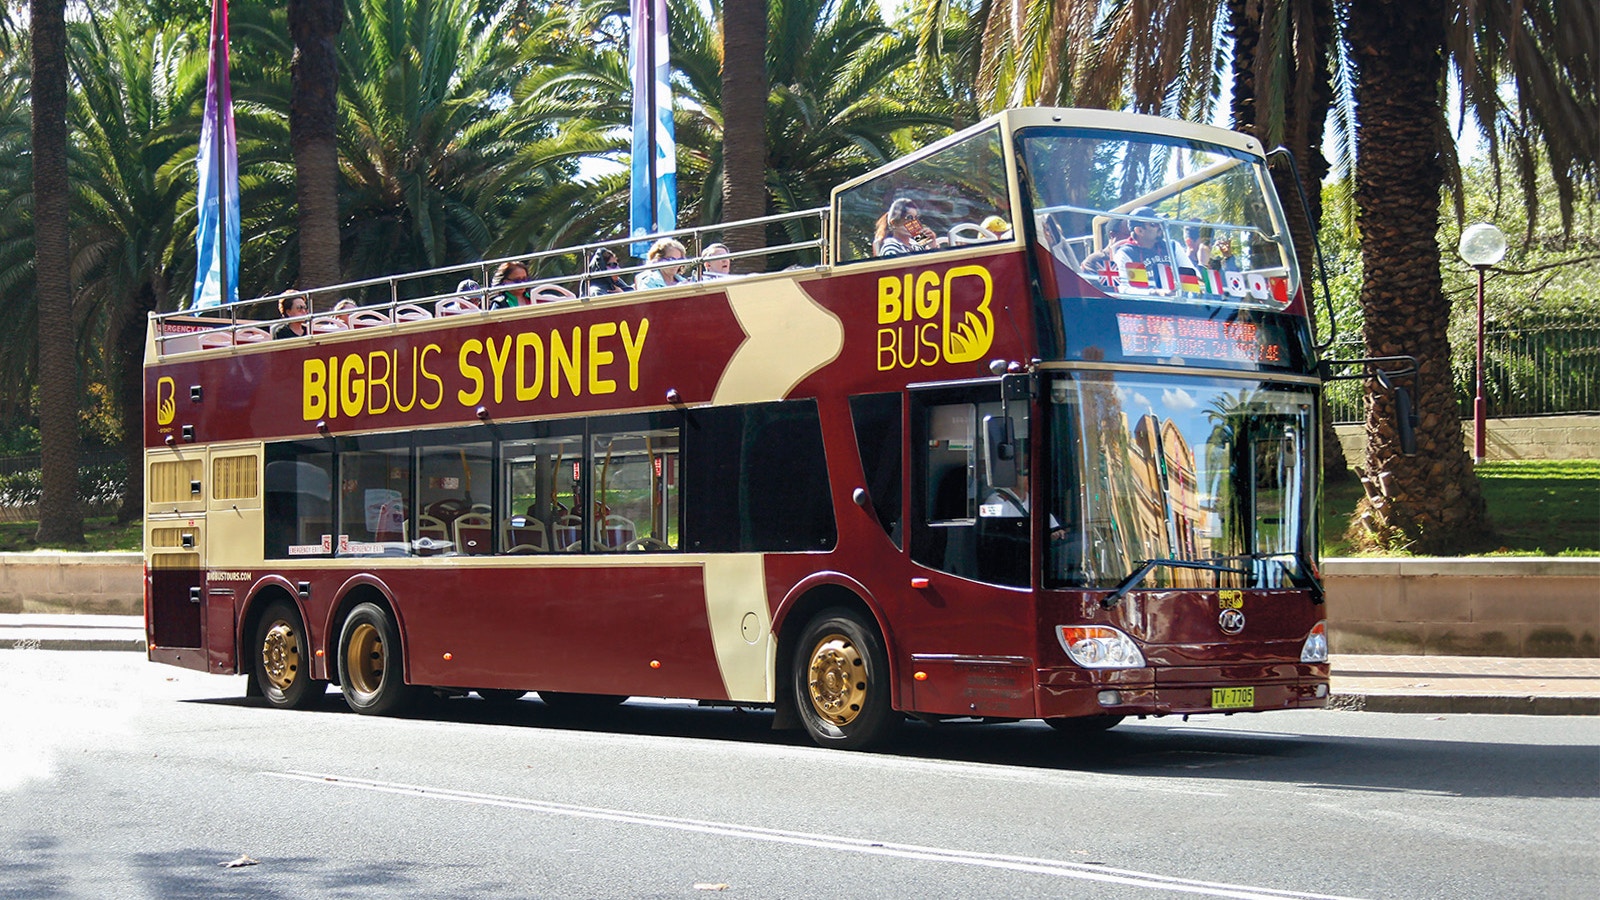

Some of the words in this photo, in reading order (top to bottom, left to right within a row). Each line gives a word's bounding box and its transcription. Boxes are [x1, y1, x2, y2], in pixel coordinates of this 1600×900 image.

[878, 270, 941, 324] BIG
[878, 322, 940, 371] BUS
[303, 344, 443, 421] BIGBUS
[458, 318, 649, 407] SYDNEY
[206, 572, 251, 581] BIGBUSTOURS.COM
[1219, 590, 1233, 599] BIG
[1219, 600, 1232, 609] BUS
